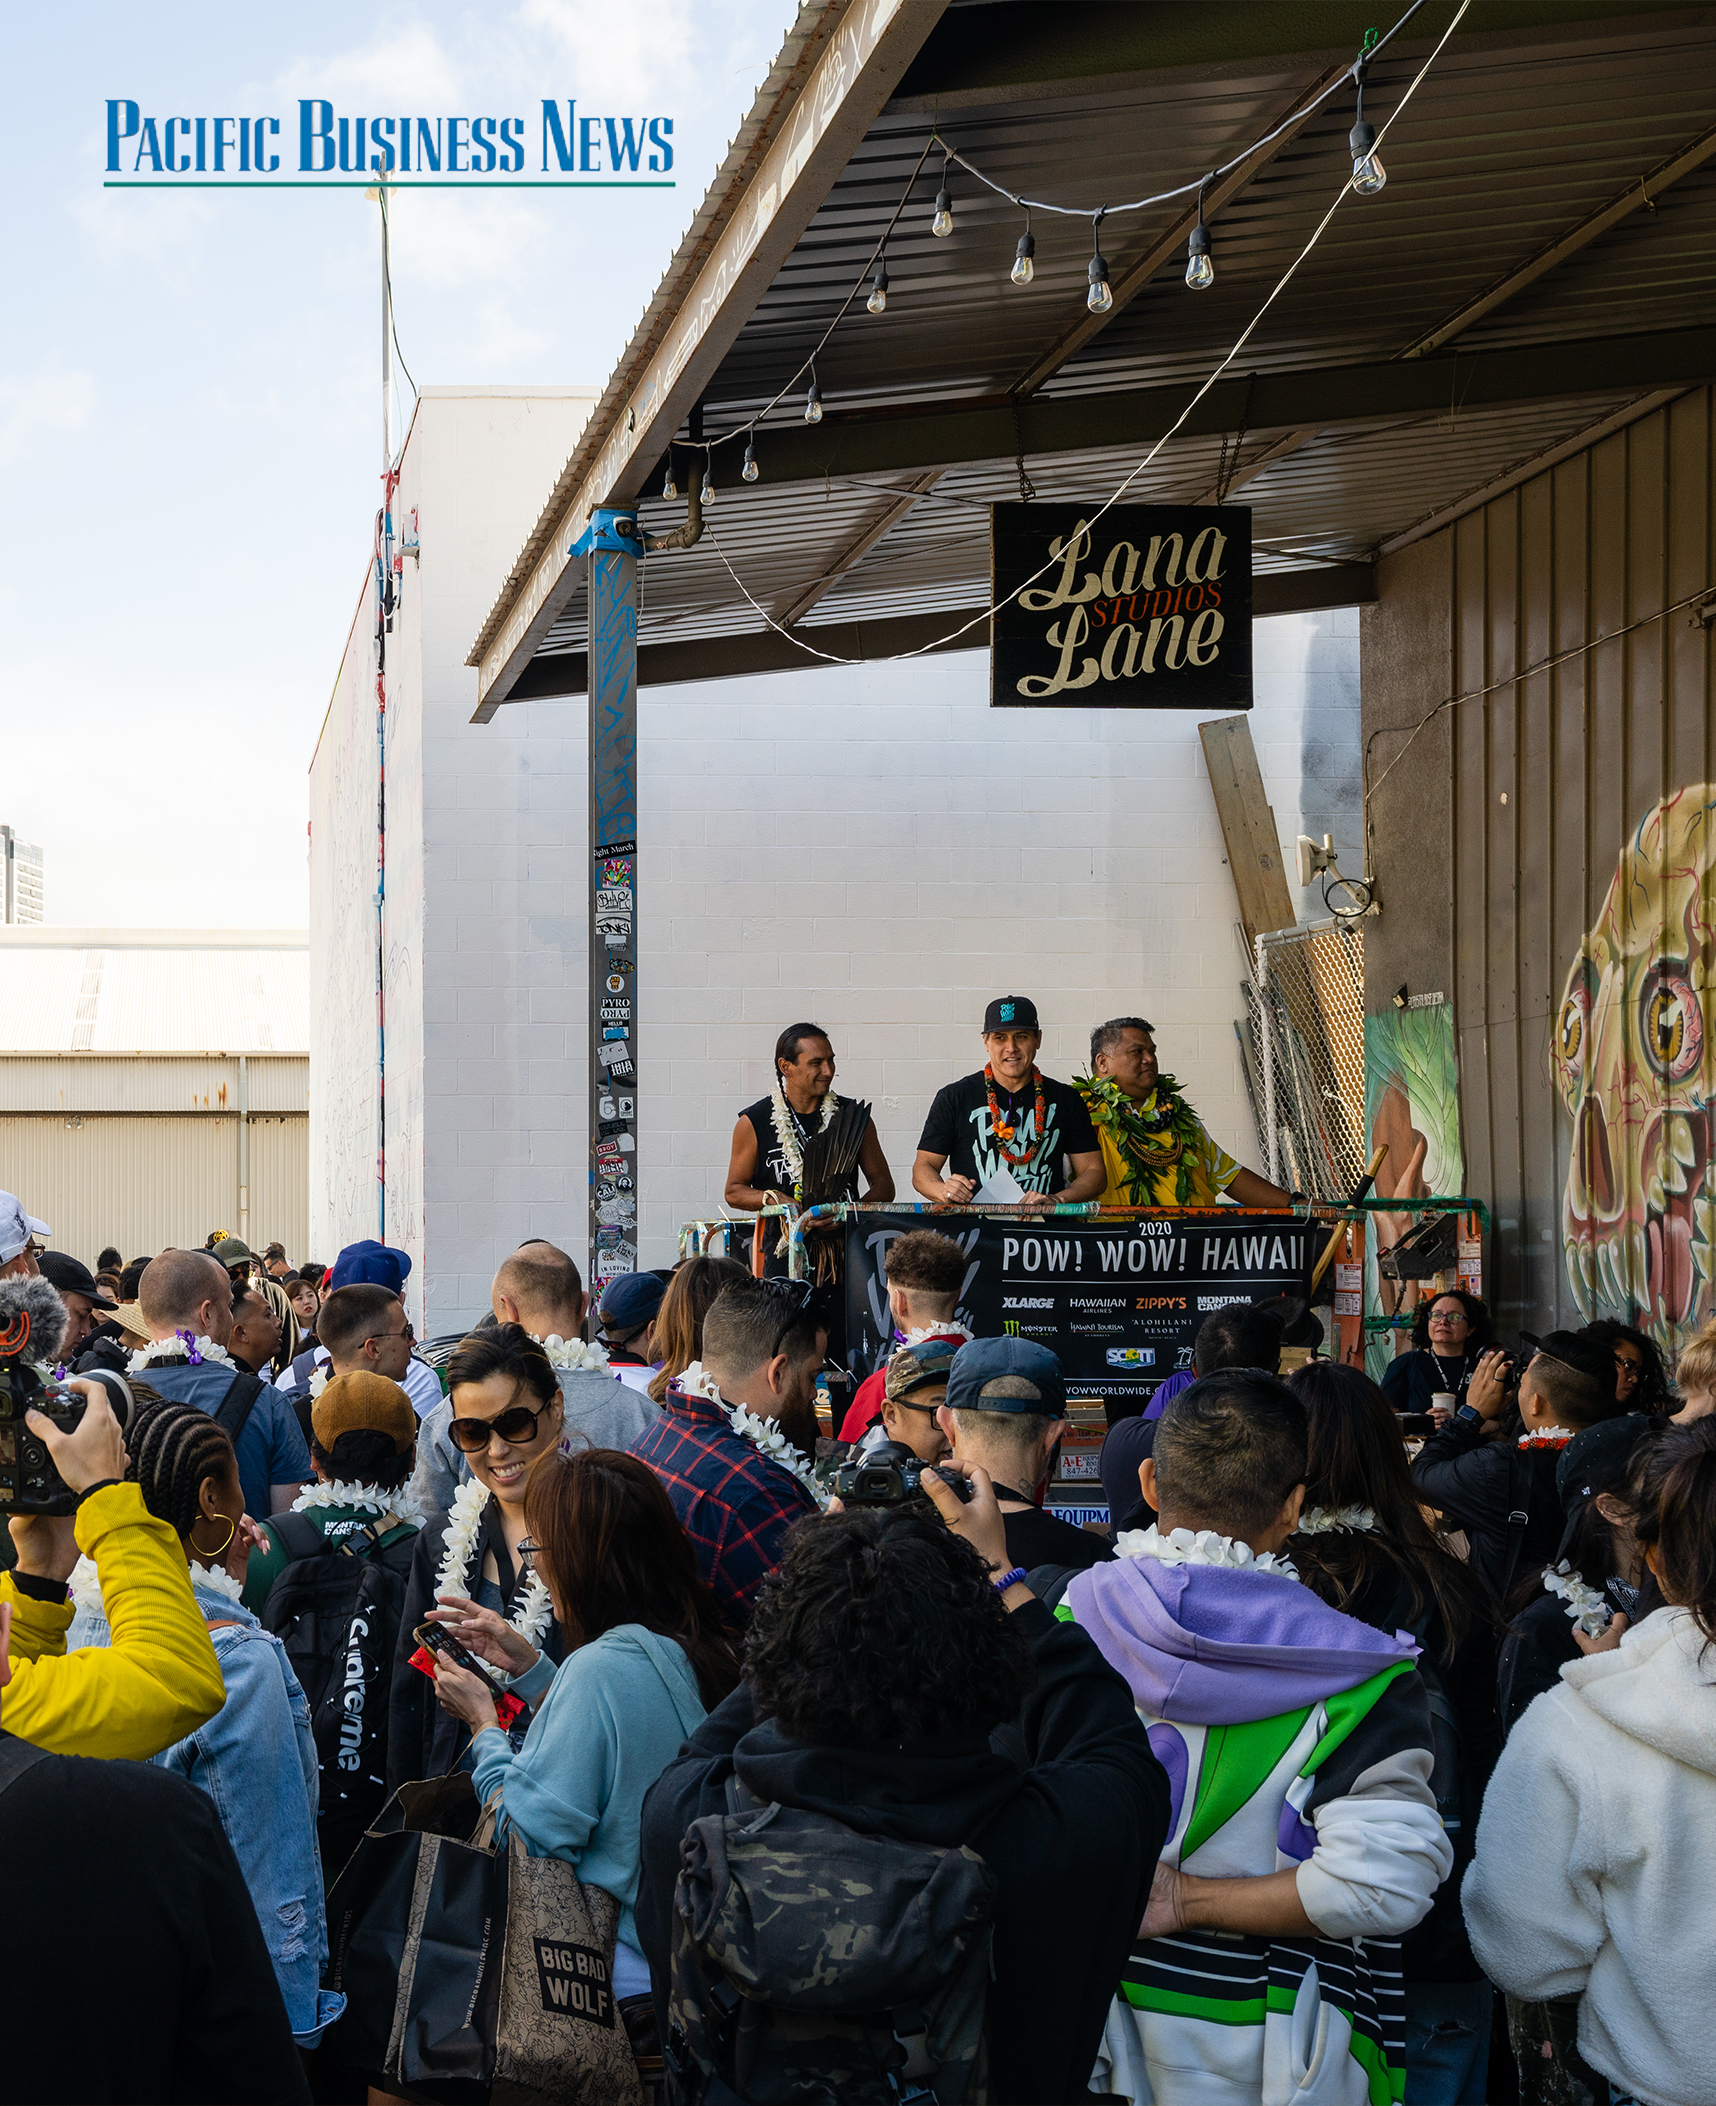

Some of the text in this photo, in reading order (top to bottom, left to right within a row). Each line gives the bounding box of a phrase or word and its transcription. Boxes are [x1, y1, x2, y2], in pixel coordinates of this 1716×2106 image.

[1018, 518, 1228, 611] Lana
[1091, 581, 1222, 628] STUDIOS
[1016, 604, 1225, 698] Lane
[602, 998, 630, 1007] PYRO
[1138, 1221, 1173, 1236] 2020
[1003, 1237, 1083, 1272] POW!
[1096, 1238, 1187, 1272] WOW!
[1201, 1235, 1305, 1271] HAWAII
[609, 1265, 631, 1273] LOVING
[1002, 1297, 1055, 1309] XLARGE
[1069, 1298, 1126, 1308] HAWAIIAN
[1135, 1297, 1187, 1310] ZIPPY'S
[1197, 1296, 1252, 1305] MONTANA
[1020, 1324, 1058, 1333] MONSTER
[1097, 1323, 1125, 1331] TOURISM
[1062, 1455, 1083, 1468] A&E
[324, 1521, 367, 1530] MONTAN
[540, 1945, 606, 1983] BIG BAD
[545, 1975, 608, 2018] WOLF
